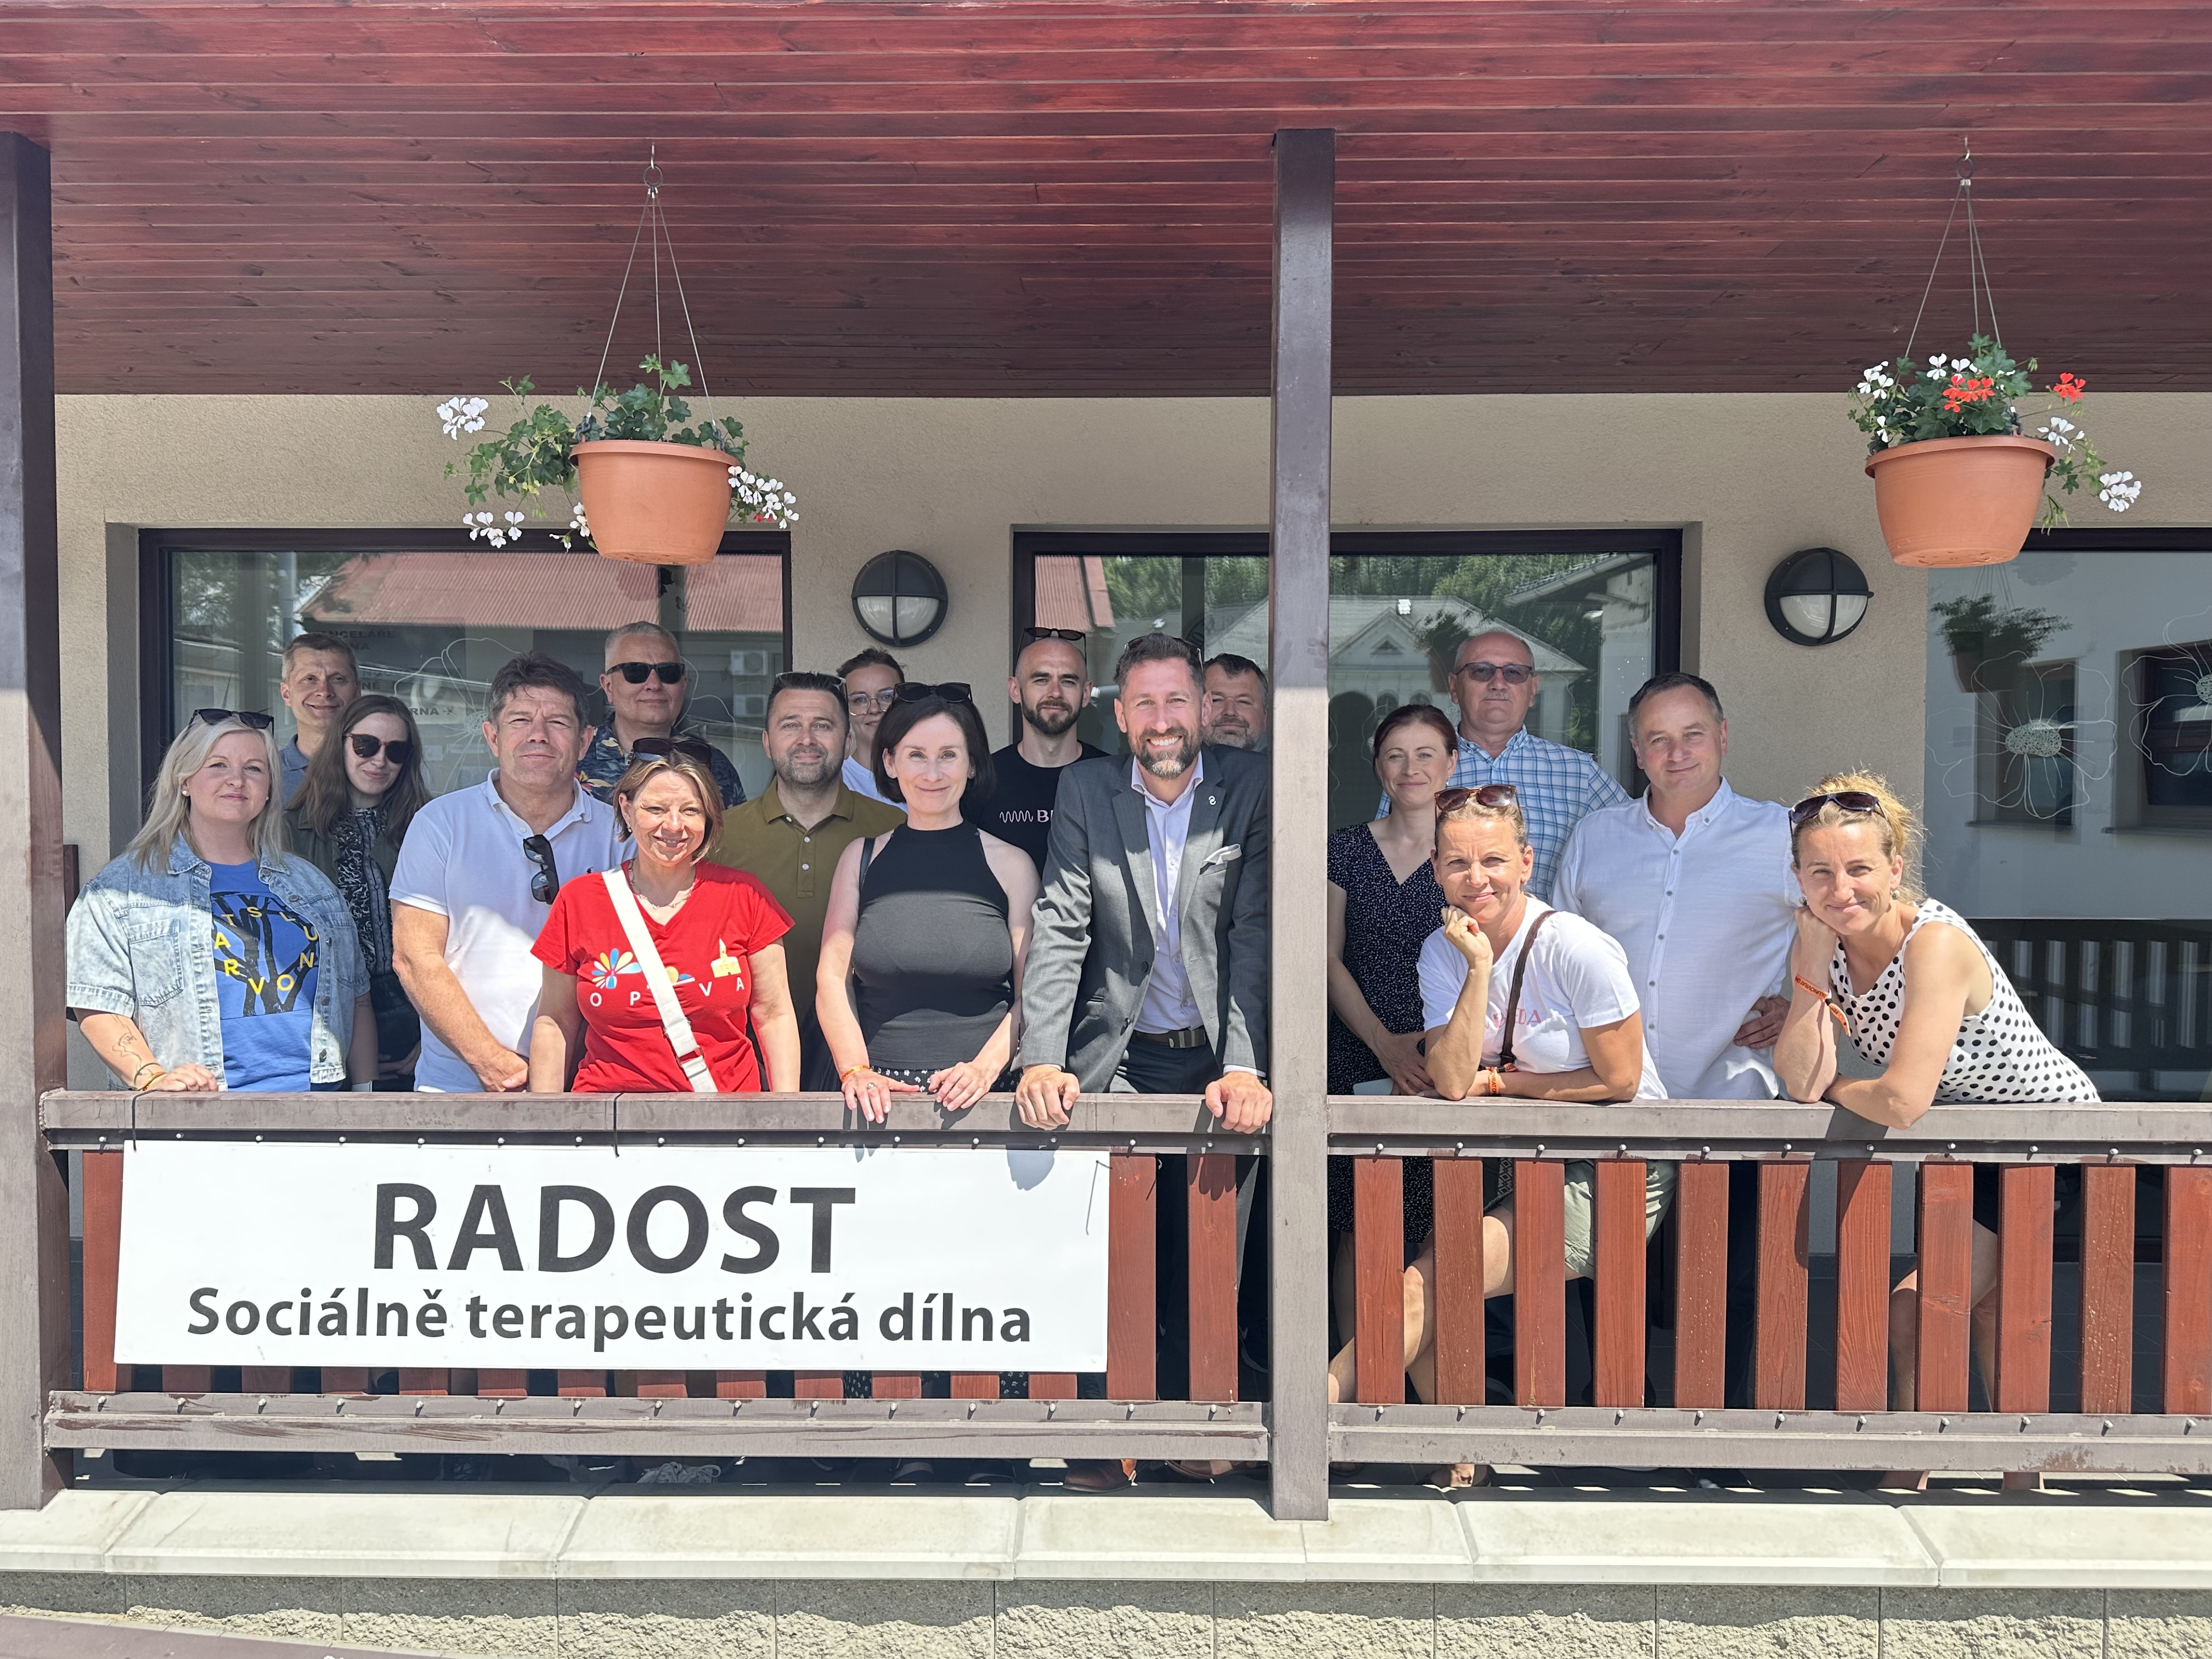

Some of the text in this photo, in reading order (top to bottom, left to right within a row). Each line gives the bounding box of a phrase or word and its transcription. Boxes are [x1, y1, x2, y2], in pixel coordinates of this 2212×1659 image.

[590, 977, 744, 1007] OPVA
[374, 1183, 856, 1273] RADOST
[188, 1287, 1030, 1352] Sociálně terapeutická dílna
